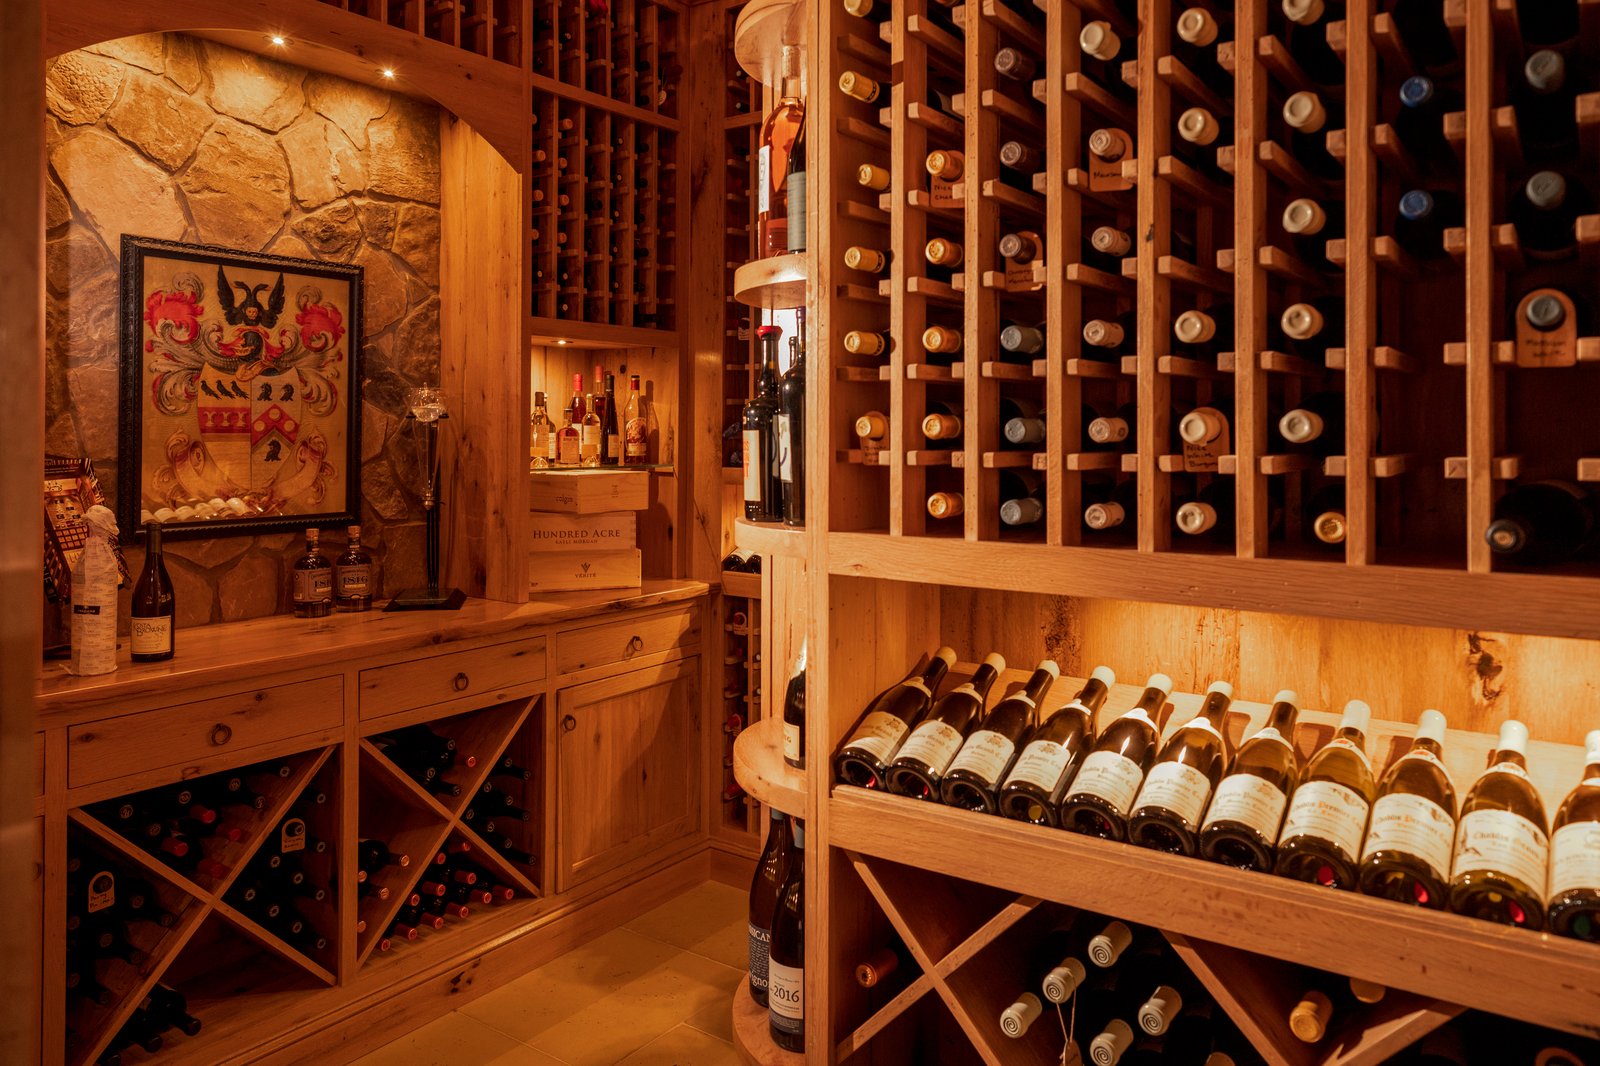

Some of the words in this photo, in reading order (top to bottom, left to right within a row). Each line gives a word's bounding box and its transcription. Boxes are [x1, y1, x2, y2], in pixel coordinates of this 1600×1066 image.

[533, 529, 588, 539] HUNDRED
[592, 529, 620, 538] ACRE
[773, 984, 800, 1003] 2016
